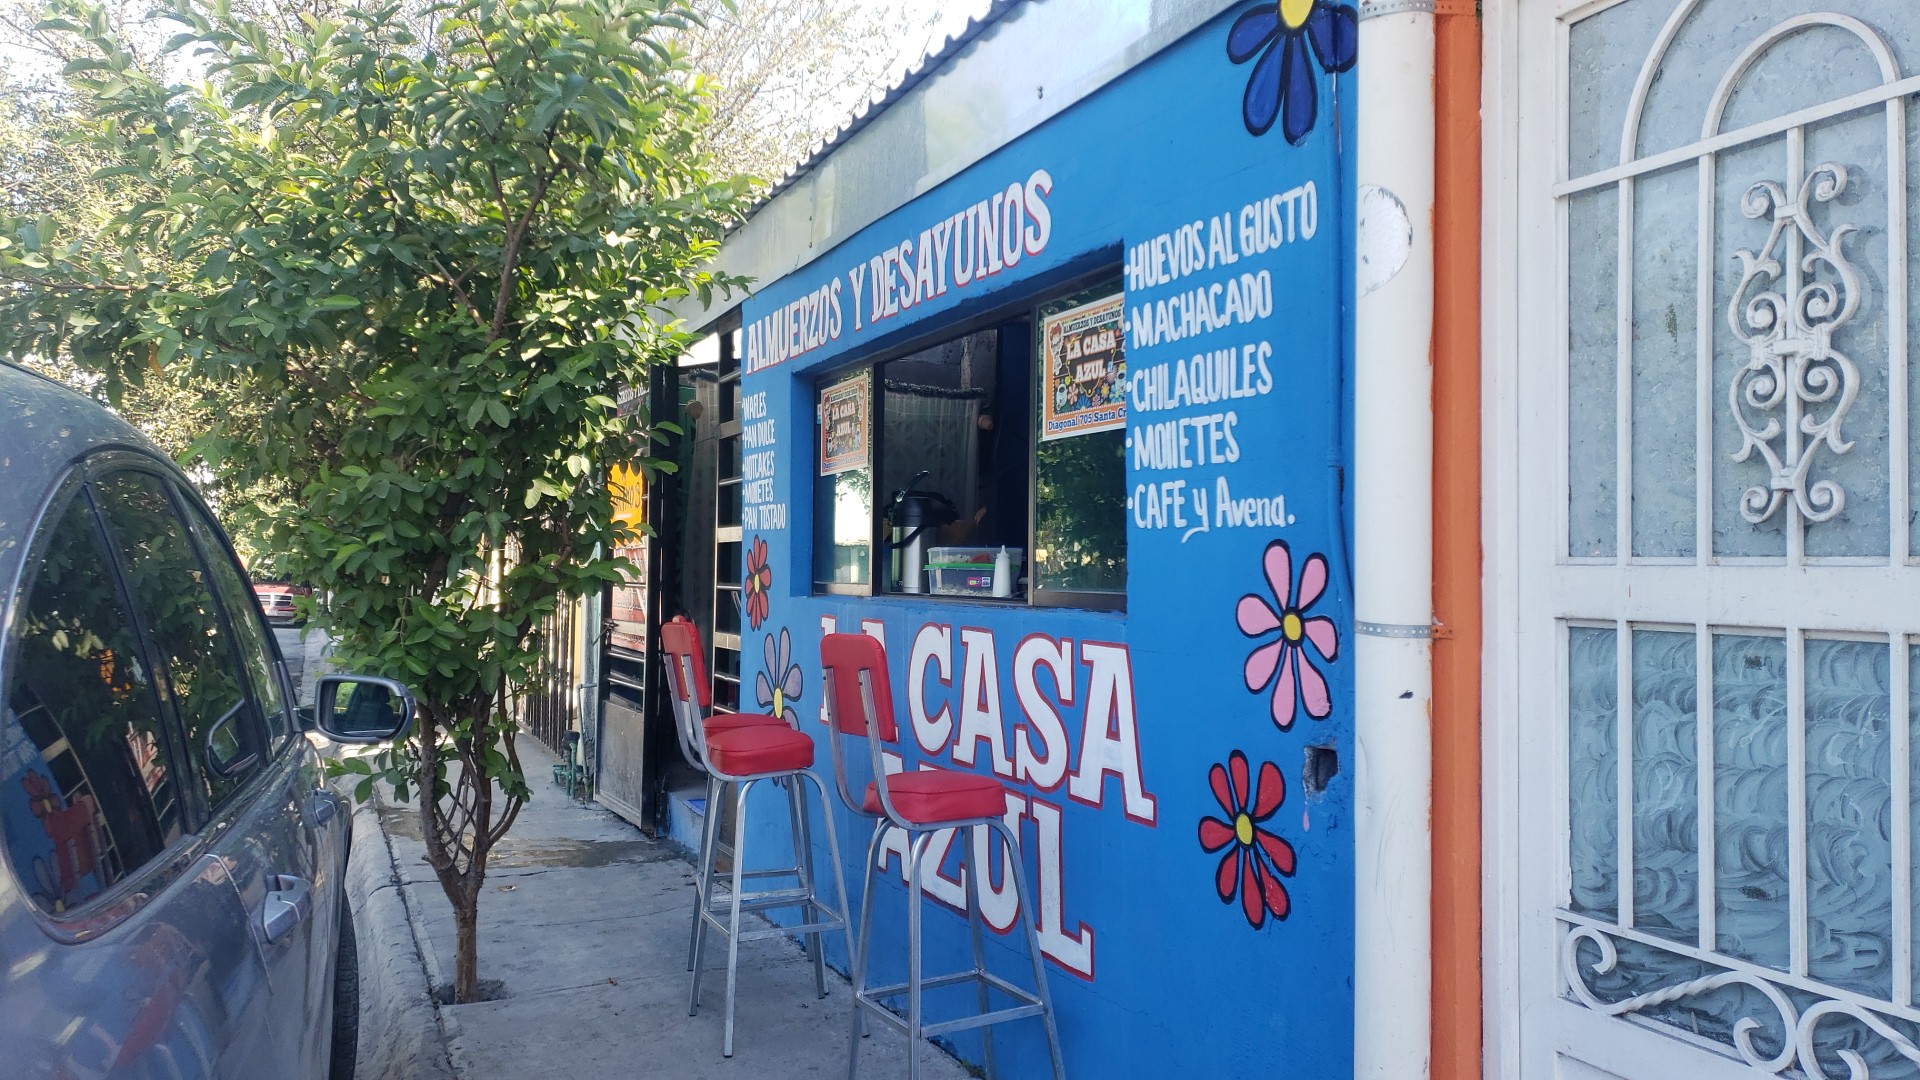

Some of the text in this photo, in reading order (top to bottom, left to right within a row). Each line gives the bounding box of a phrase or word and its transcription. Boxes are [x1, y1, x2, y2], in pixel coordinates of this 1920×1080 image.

[1129, 180, 1319, 292] HUEVOS AL GUSTO
[746, 168, 1053, 375] ALMUERZOS Y DESAYUNOS
[1133, 269, 1273, 351] MACHACADO
[1066, 331, 1117, 361] LA CASA
[1075, 359, 1106, 384] AZUL
[1132, 340, 1273, 413] CHILAQUILES
[840, 403, 856, 416] CASA
[1048, 417, 1079, 432] Diagonal
[1079, 412, 1093, 426] 705
[1093, 410, 1117, 422] Santa
[744, 419, 775, 450] PAN DULCE
[744, 450, 774, 480] HOTCAKES
[744, 503, 786, 530] PAN TOSTADO
[1134, 479, 1188, 529] CAFE
[1216, 475, 1296, 529] Avena.
[908, 622, 1157, 828] CASA
